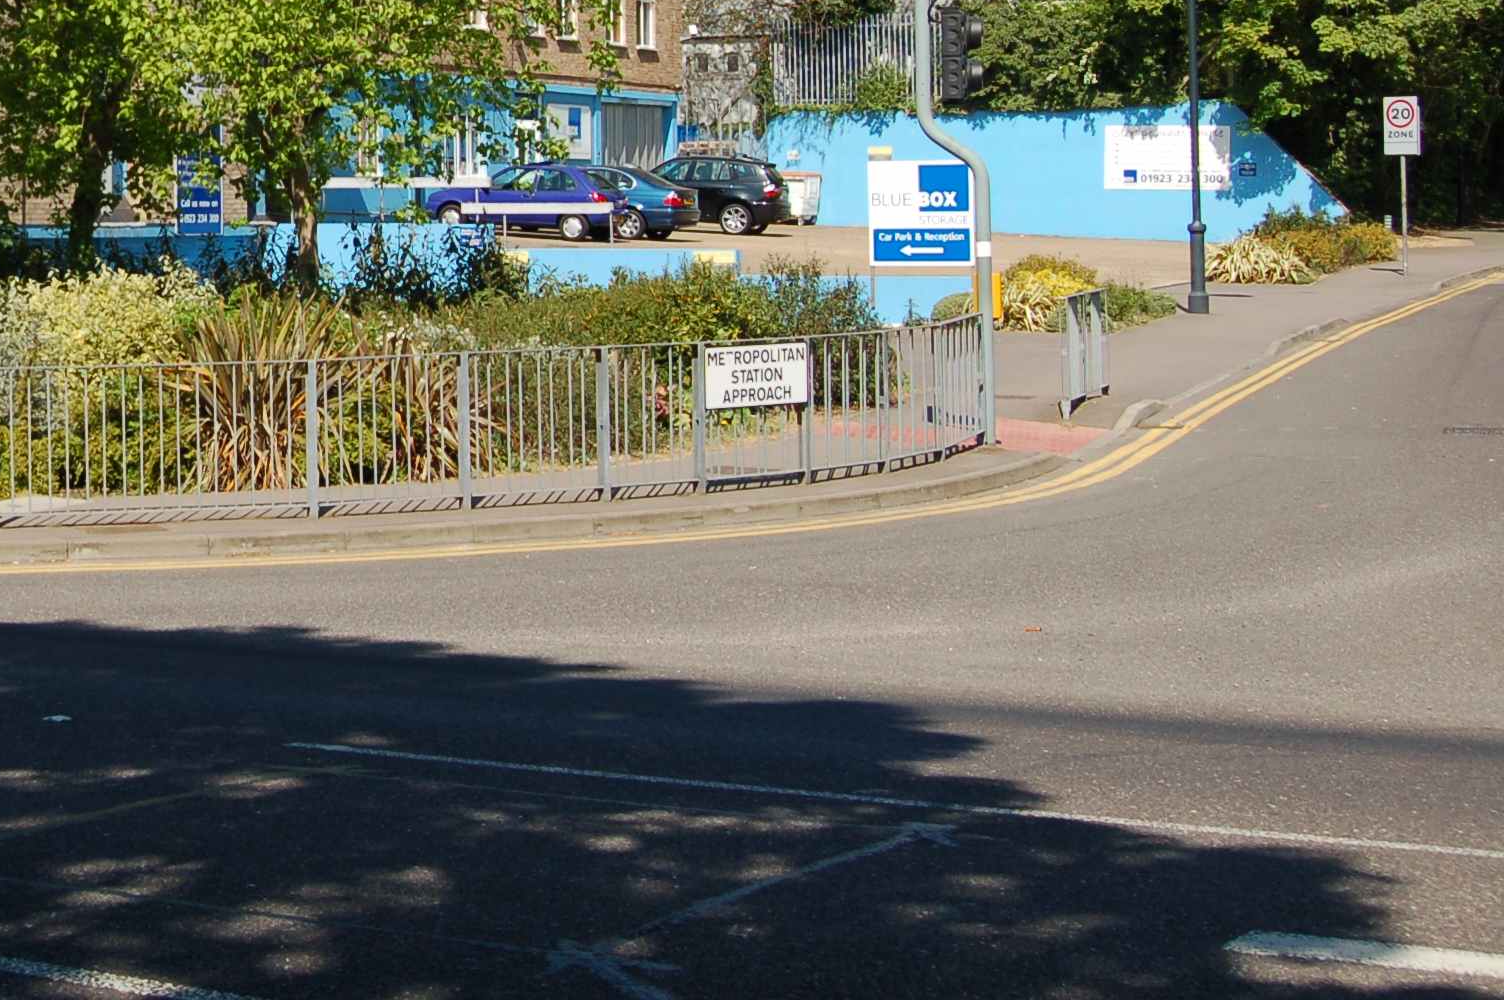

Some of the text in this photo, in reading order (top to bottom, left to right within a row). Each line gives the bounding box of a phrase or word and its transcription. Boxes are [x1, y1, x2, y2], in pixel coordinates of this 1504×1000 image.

[1391, 107, 1411, 120] 20
[1388, 130, 1414, 139] ZONE
[1140, 173, 1173, 184] 01923
[1177, 173, 1194, 184] 23
[1203, 173, 1224, 184] 300
[871, 190, 958, 208] BLUE BOX
[919, 215, 969, 225] STORAGE
[878, 232, 893, 242] Car
[895, 232, 913, 242] Park
[924, 232, 965, 243] Reception
[731, 367, 784, 384] STATION
[722, 385, 792, 404] APPROACH
